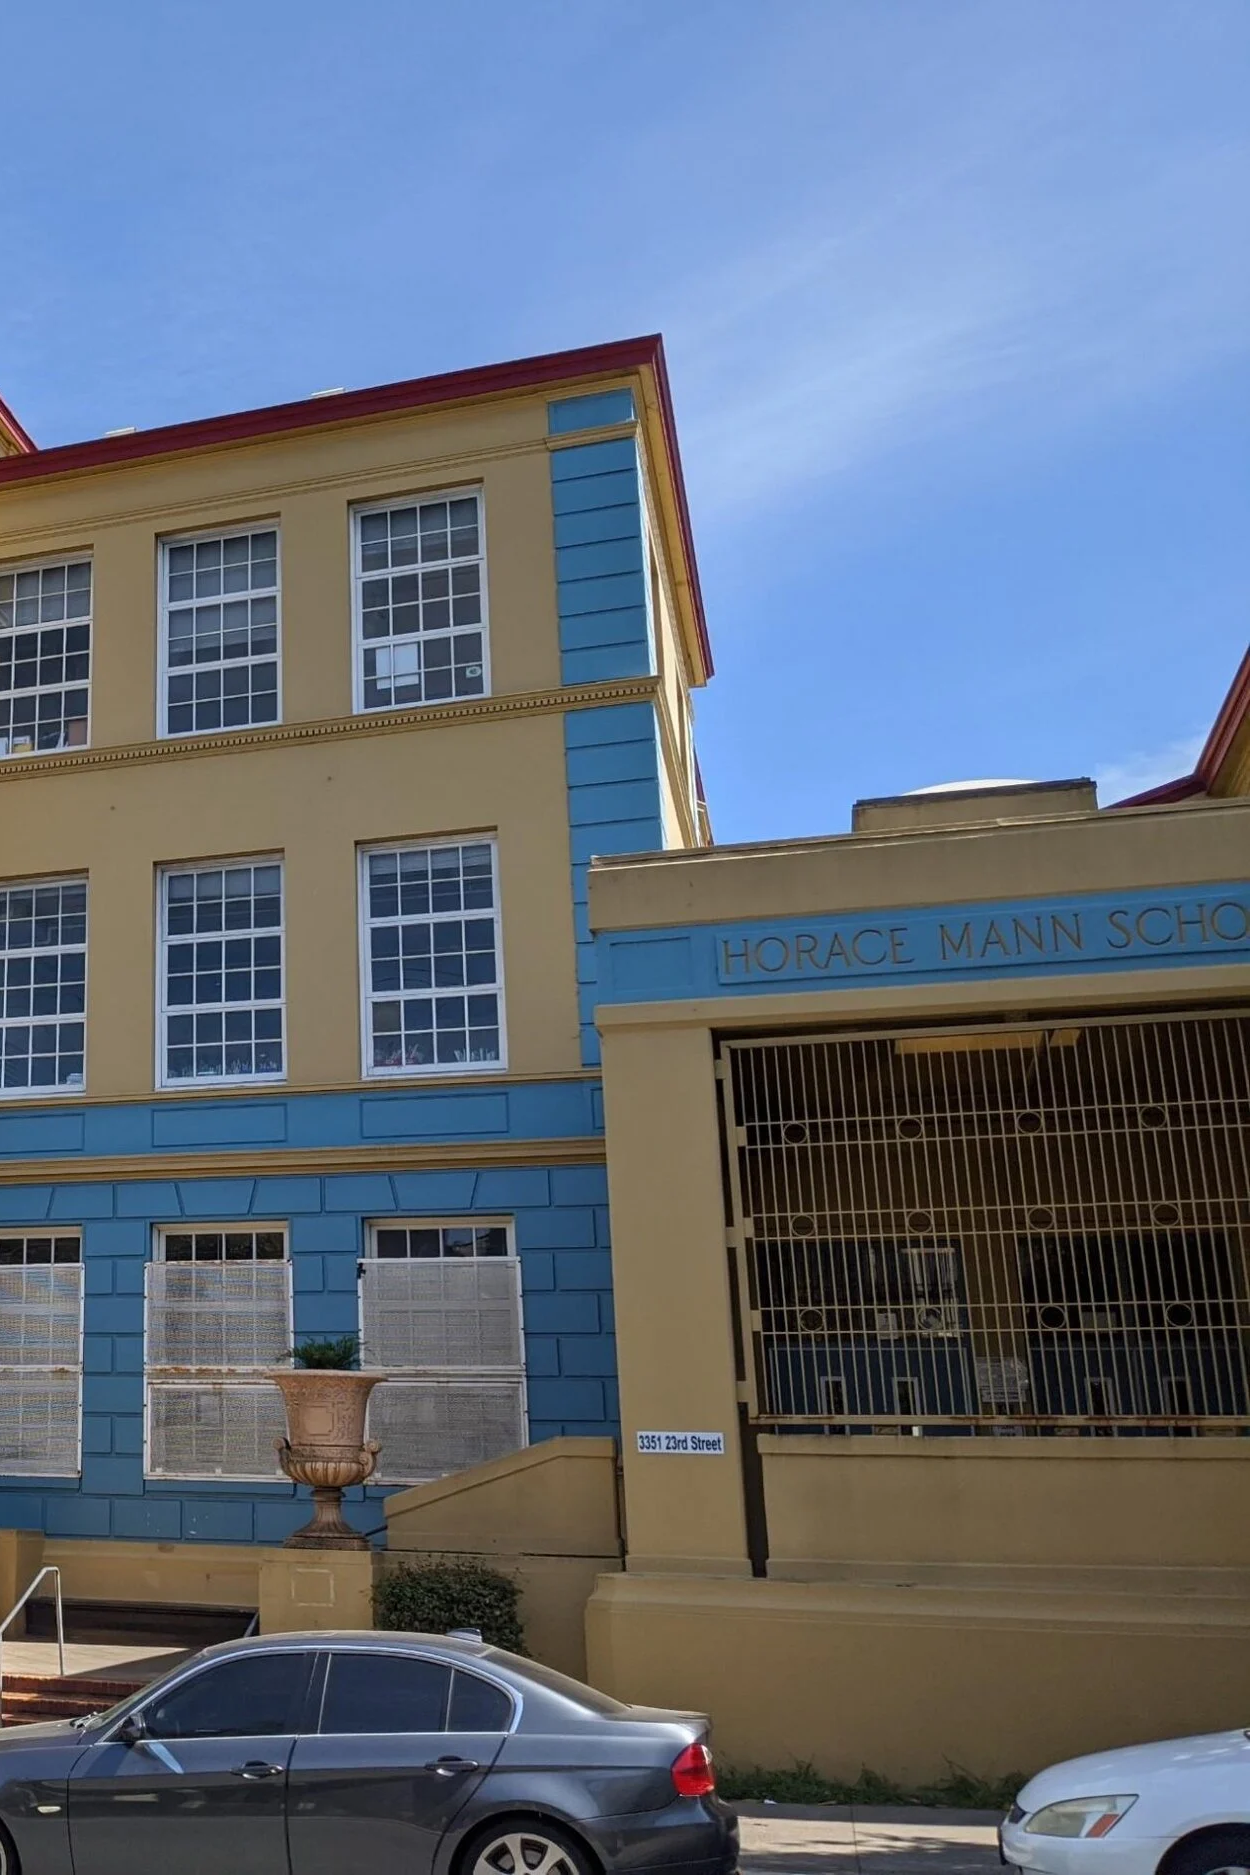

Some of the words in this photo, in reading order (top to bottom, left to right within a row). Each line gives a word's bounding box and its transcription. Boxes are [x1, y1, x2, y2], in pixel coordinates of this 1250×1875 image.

[721, 927, 915, 975] HORACE
[939, 912, 1084, 960] MANN
[638, 1435, 662, 1450] 3351
[665, 1435, 688, 1451] 23rd
[690, 1435, 722, 1451] Street
